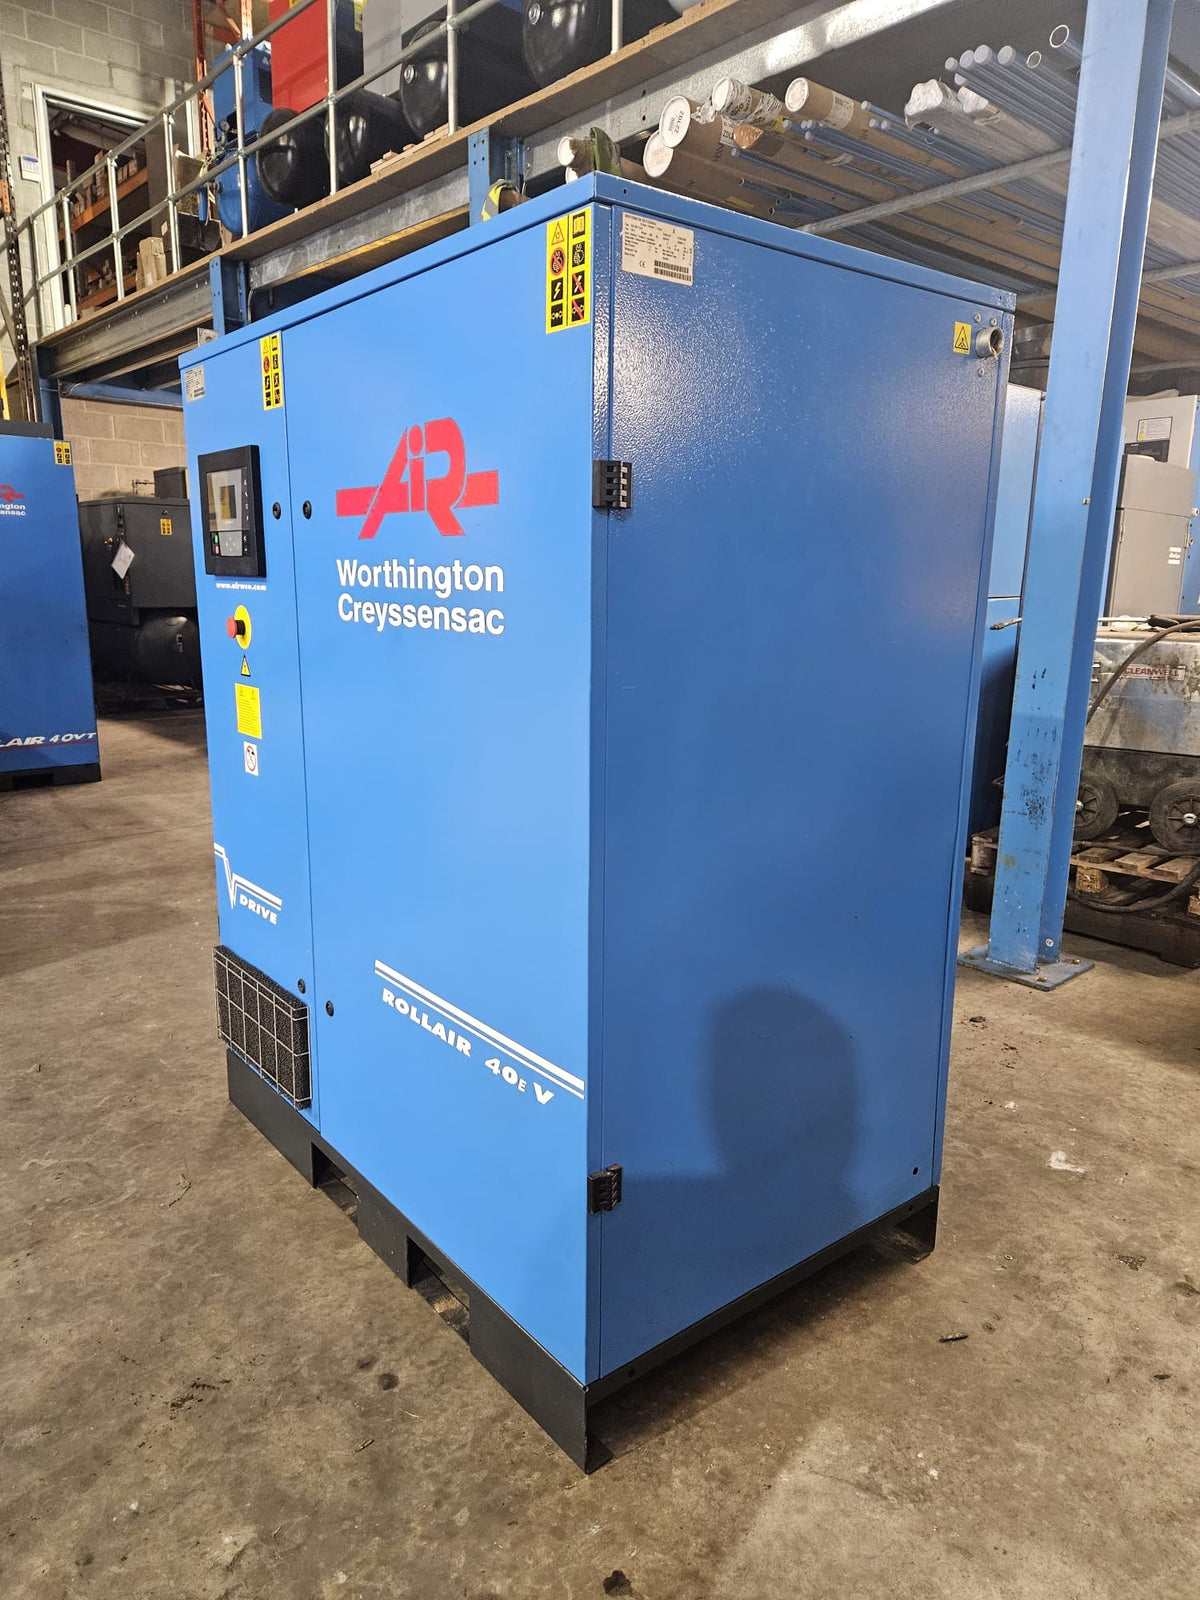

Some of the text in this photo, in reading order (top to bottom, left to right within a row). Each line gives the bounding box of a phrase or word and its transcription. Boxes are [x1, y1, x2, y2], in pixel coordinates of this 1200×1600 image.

[336, 558, 505, 599] Worthington
[337, 593, 505, 635] Creyssensac
[1124, 667, 1180, 677] CLEANWELL
[239, 893, 278, 925] DRIVE
[381, 987, 473, 1058] ROLLAIR
[532, 1081, 555, 1105] V
